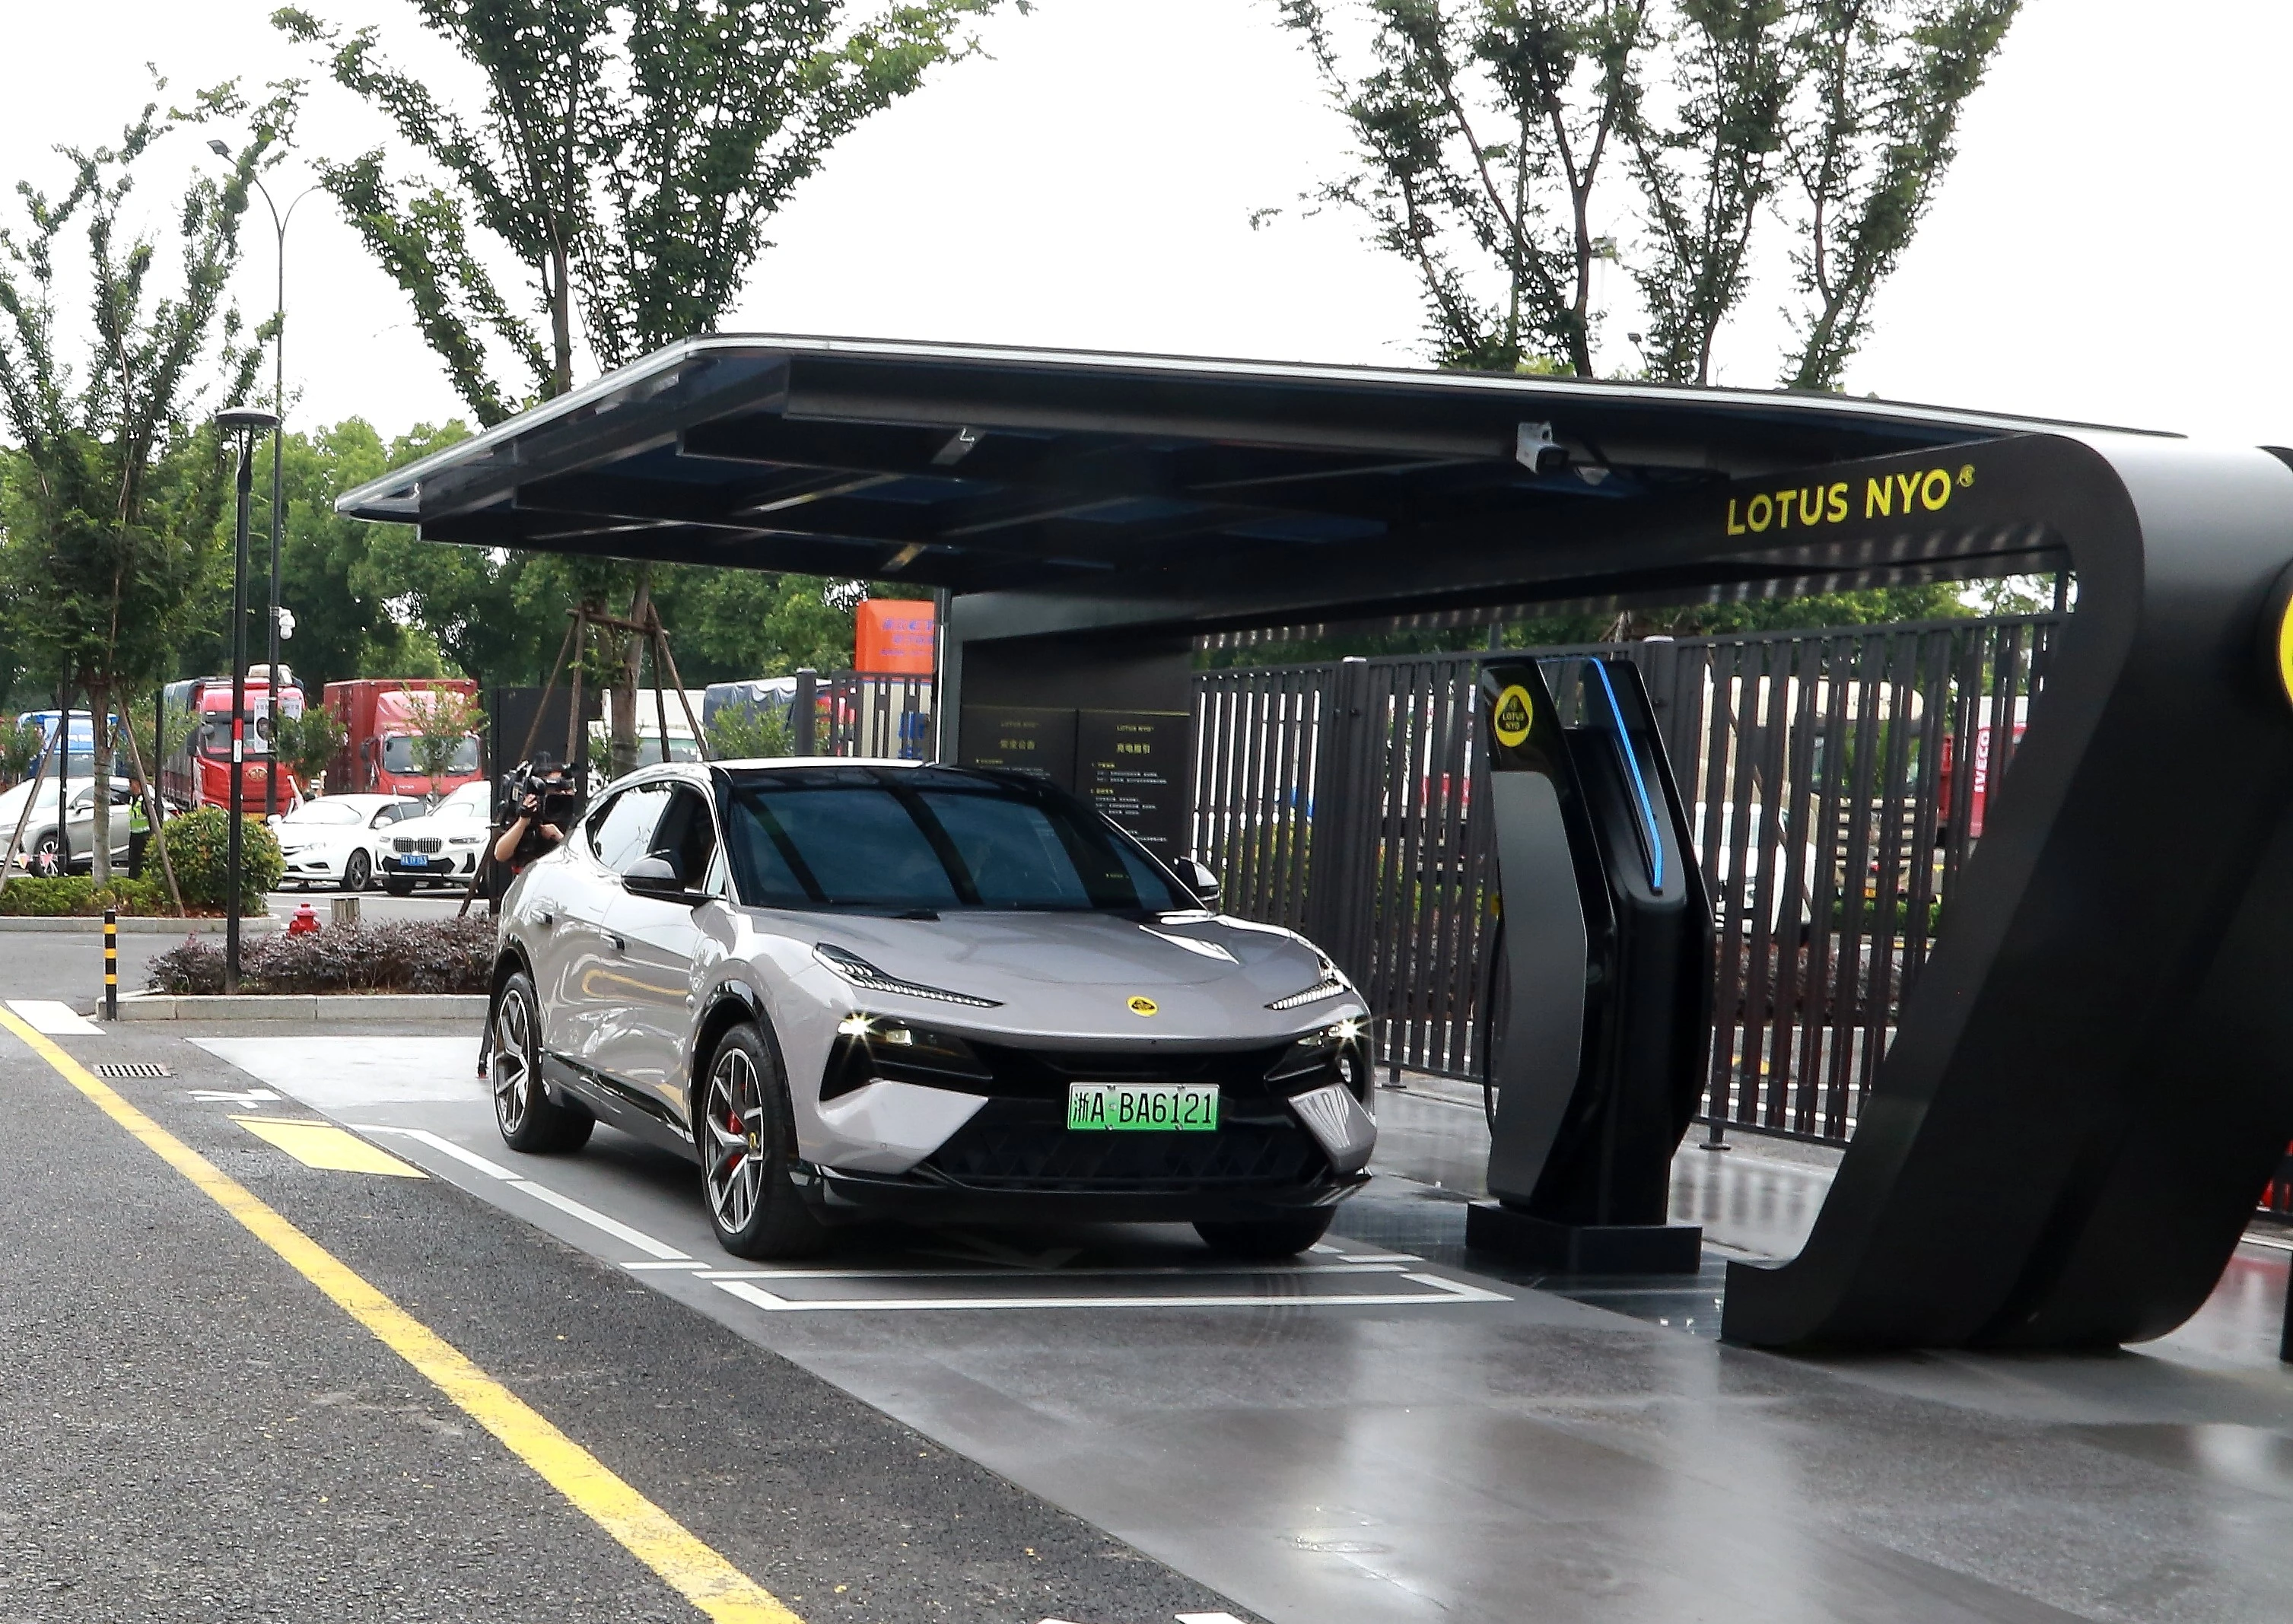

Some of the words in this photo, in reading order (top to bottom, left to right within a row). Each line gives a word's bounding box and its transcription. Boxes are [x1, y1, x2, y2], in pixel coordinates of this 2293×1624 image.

[1728, 481, 1849, 536] LOTUS
[1503, 713, 1525, 721] LOTUS
[1973, 730, 1990, 793] IVECO
[1073, 1092, 1104, 1123] 浙A
[1119, 1092, 1211, 1123] BA6121
